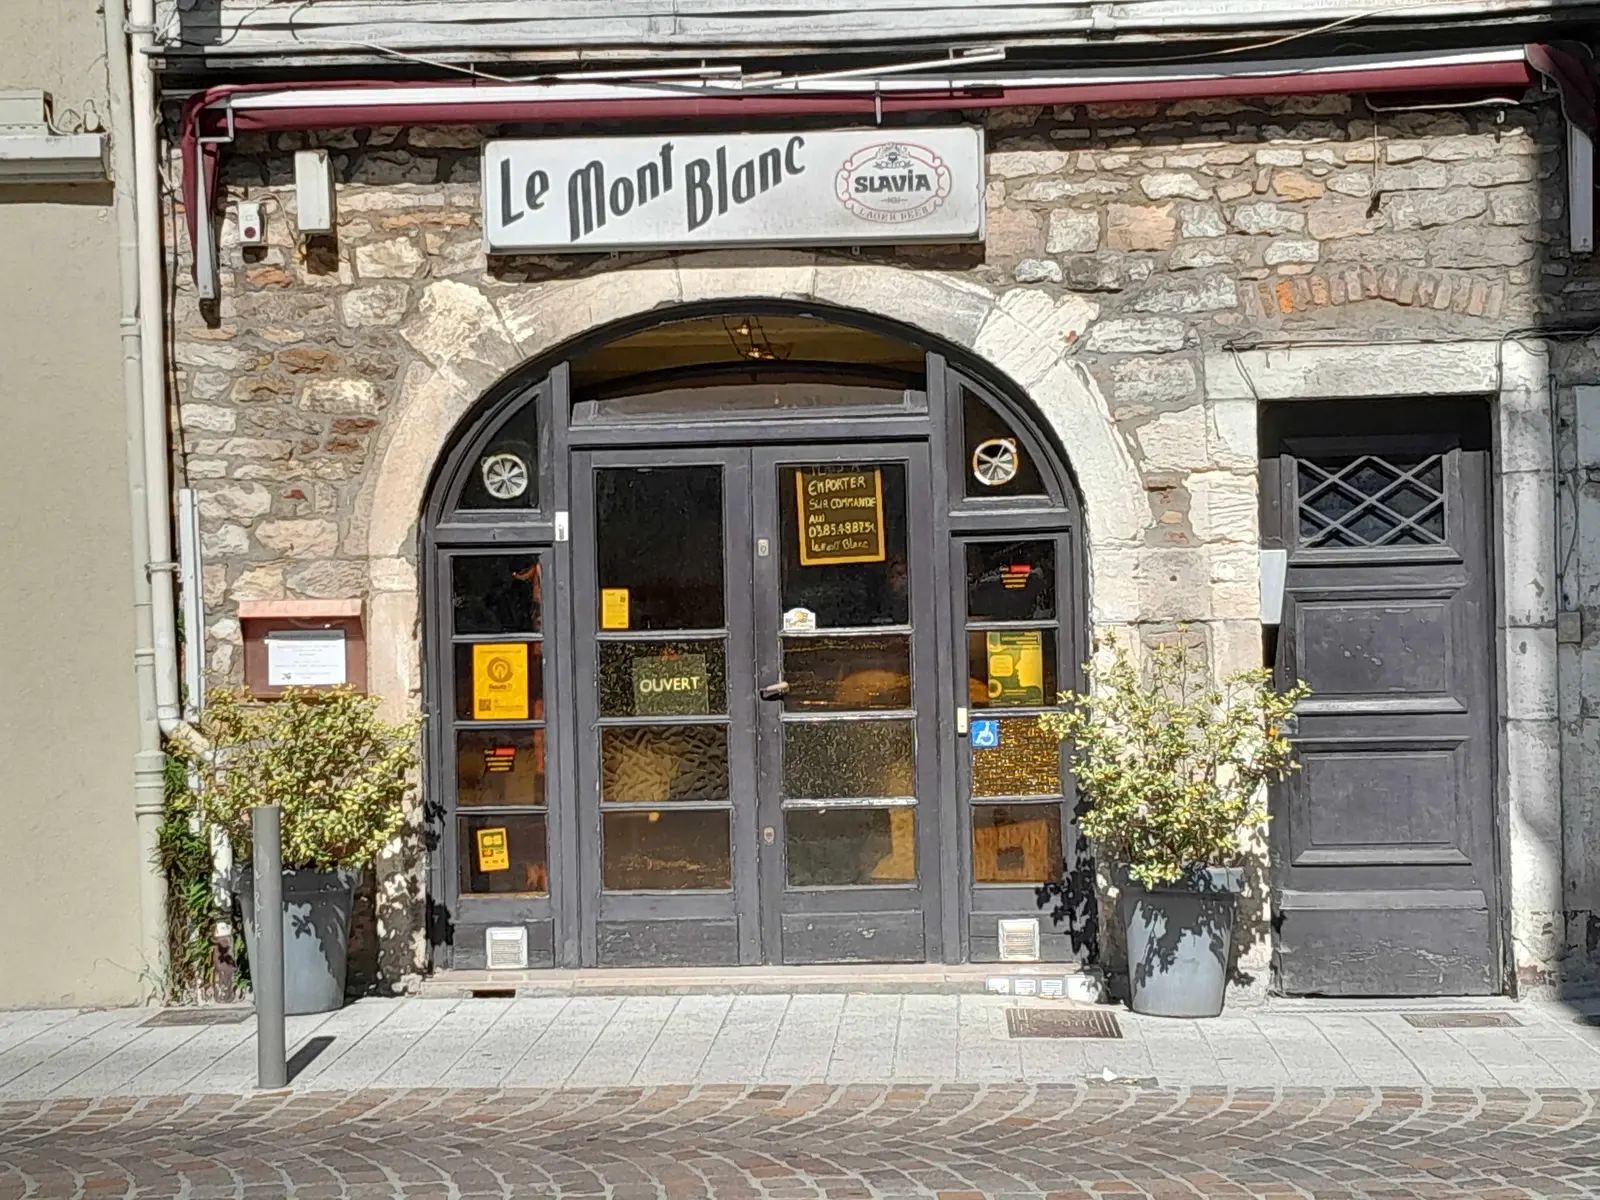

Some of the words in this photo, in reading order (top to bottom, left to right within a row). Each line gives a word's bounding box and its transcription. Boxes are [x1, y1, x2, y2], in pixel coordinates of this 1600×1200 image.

[500, 158, 549, 228] Le
[568, 141, 674, 242] Mont
[685, 136, 806, 233] Blanc
[854, 169, 931, 193] SLAVIA
[808, 475, 866, 496] EMPORTER
[809, 498, 829, 510] SUR
[830, 497, 876, 509] COMMANDE
[639, 677, 700, 692] OUVERT
